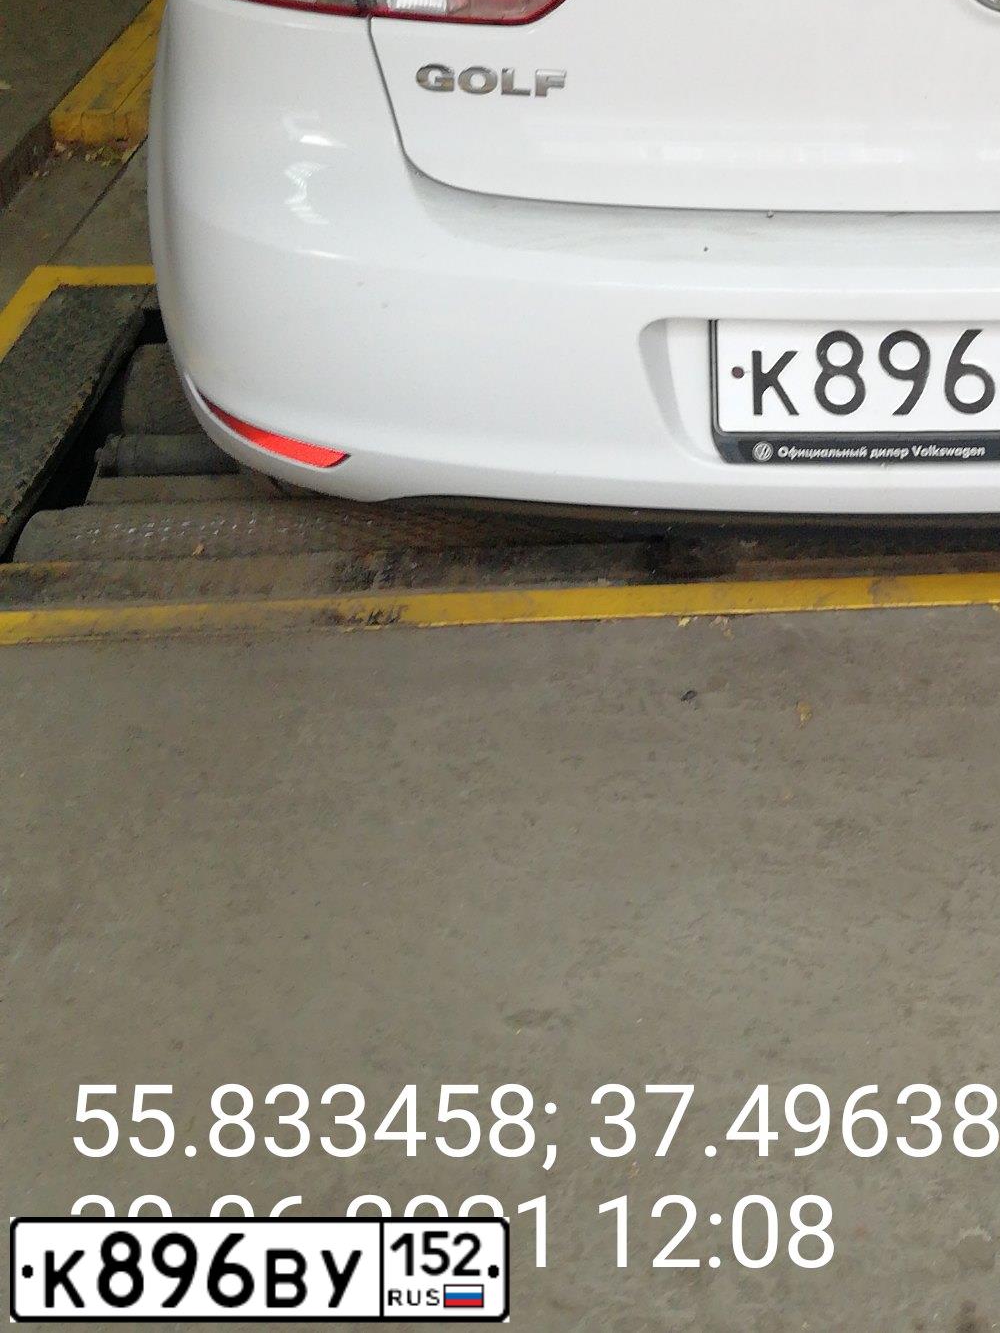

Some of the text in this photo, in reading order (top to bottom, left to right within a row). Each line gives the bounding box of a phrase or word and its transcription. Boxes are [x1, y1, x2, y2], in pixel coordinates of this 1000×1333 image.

[415, 63, 567, 98] GOLF
[777, 445, 867, 460] Официальный
[870, 447, 909, 460] дилер
[912, 444, 986, 458] Volkswagen
